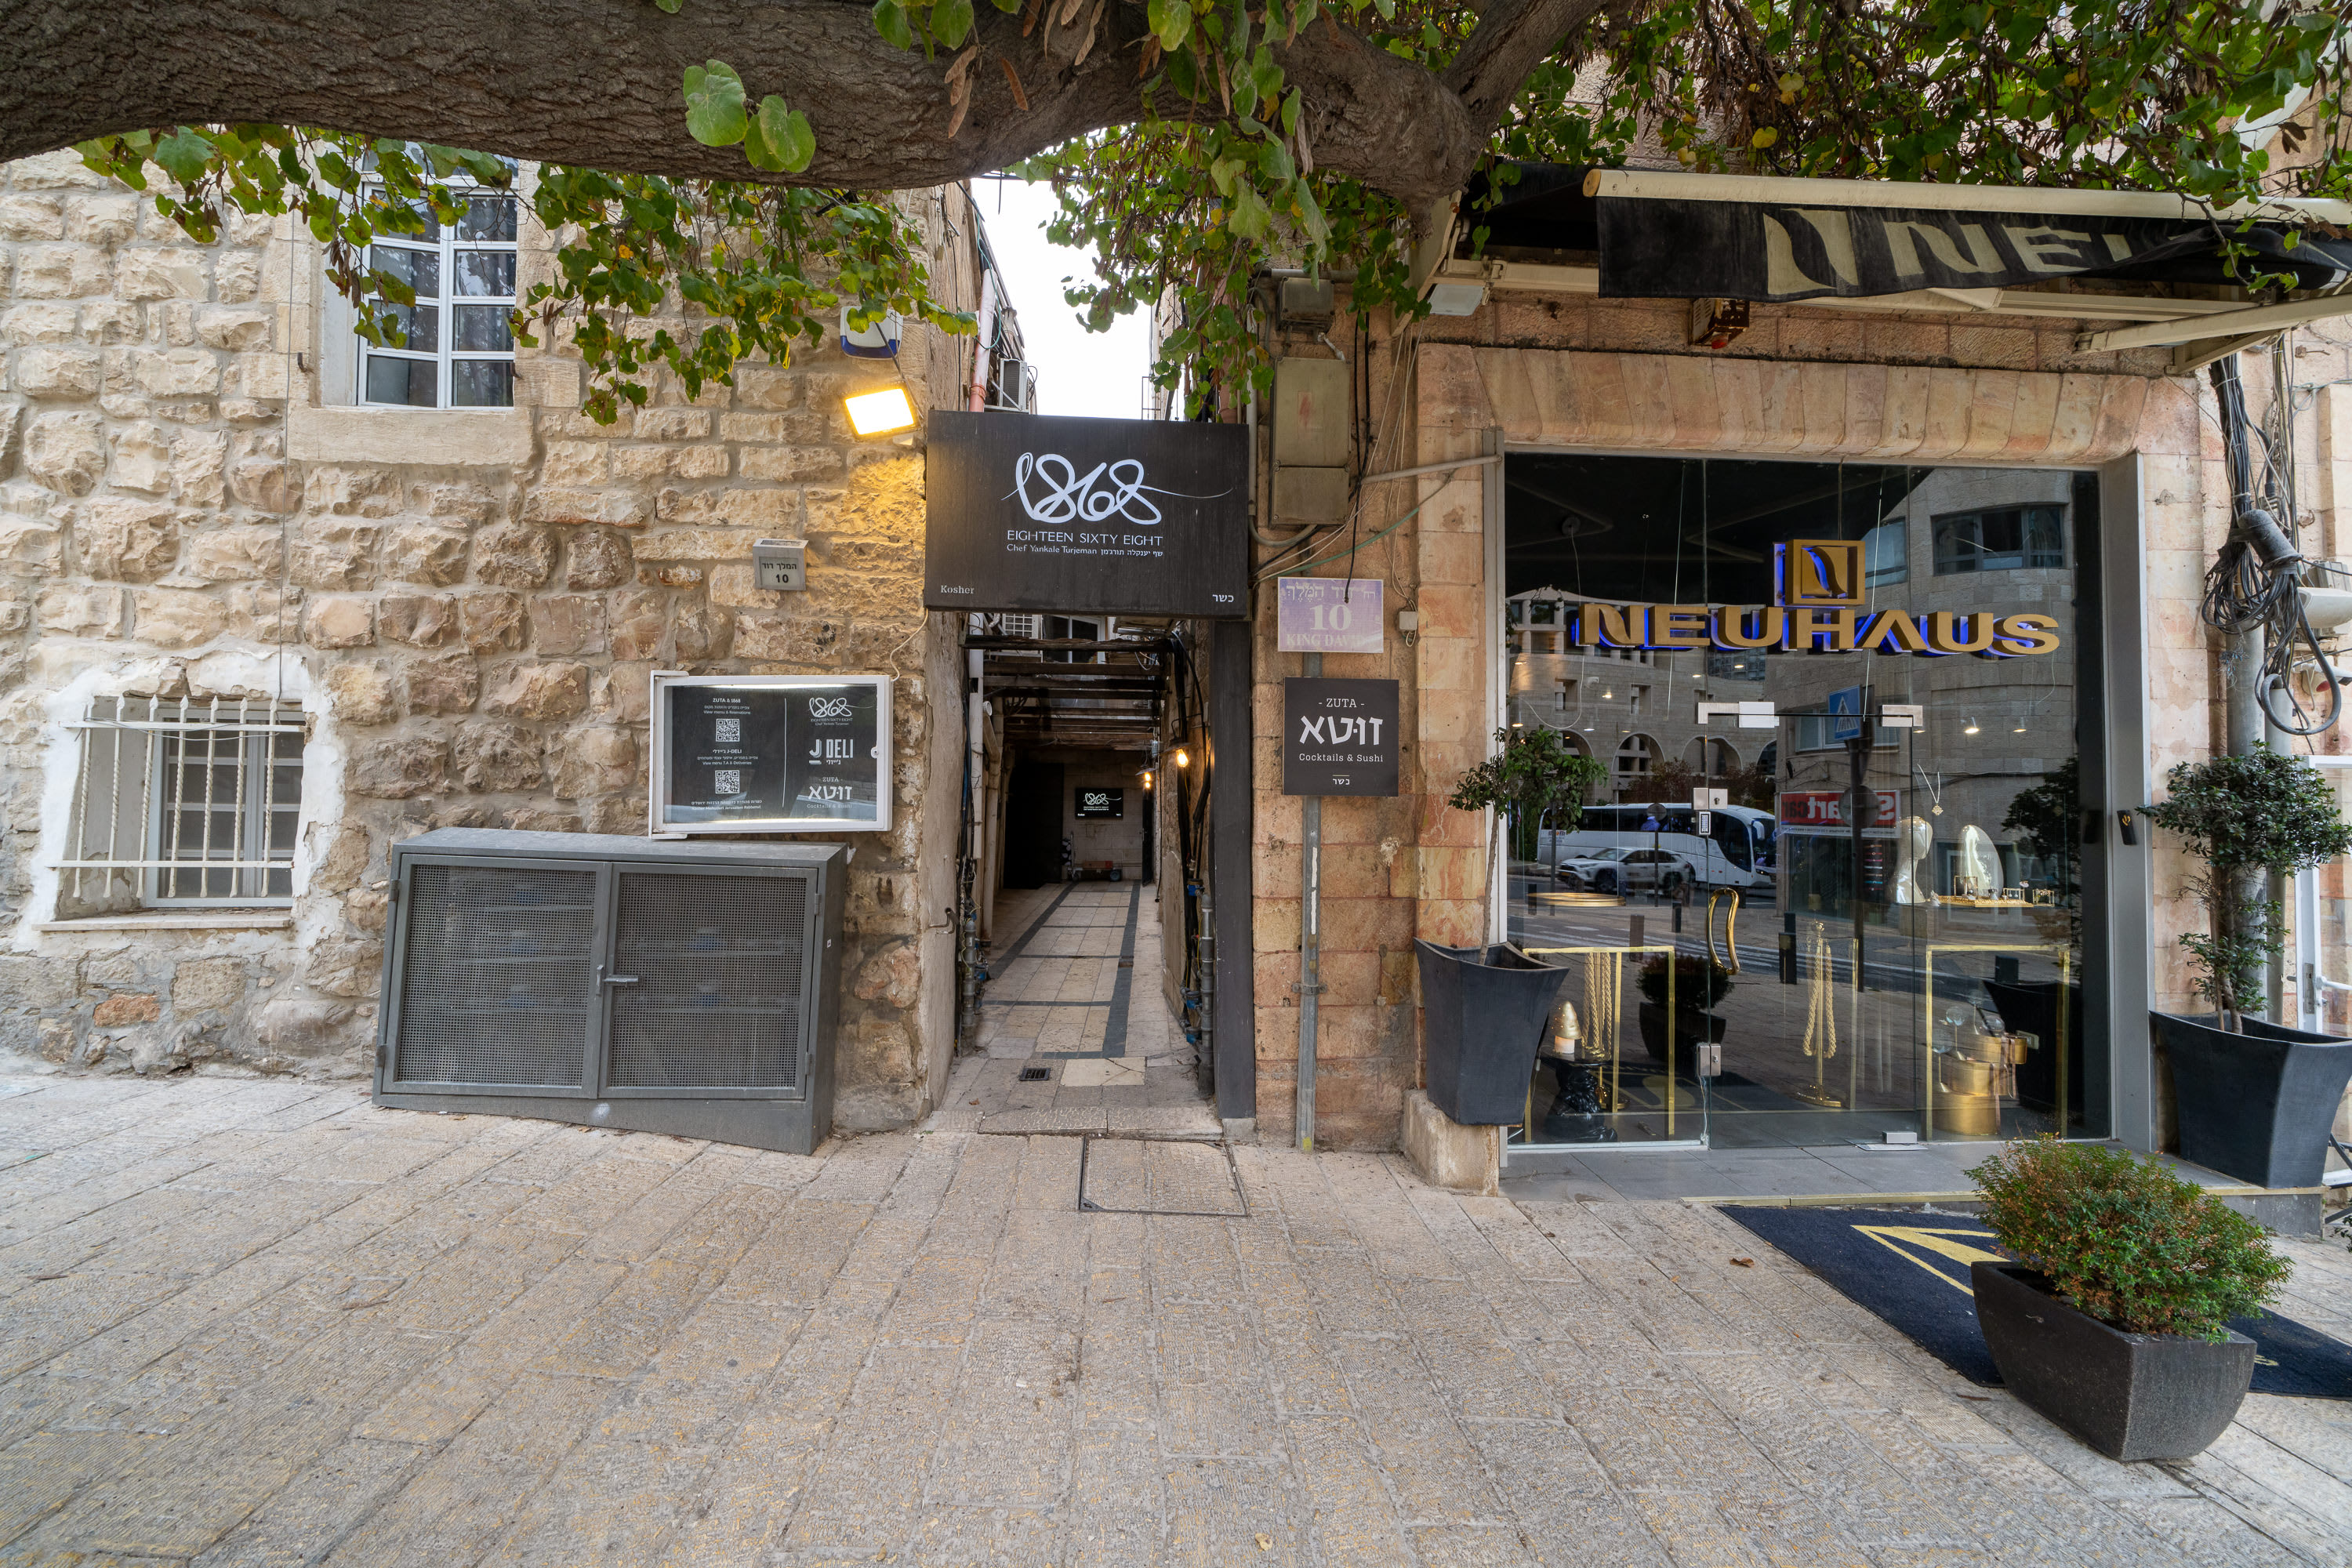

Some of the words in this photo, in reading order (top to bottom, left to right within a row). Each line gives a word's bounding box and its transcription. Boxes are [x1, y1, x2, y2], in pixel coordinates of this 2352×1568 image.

[1001, 452, 1167, 525] 1868
[1007, 530, 1074, 543] EIGHTEEN
[1080, 532, 1119, 545] SIXTY
[1123, 535, 1163, 546] EIGHT
[1007, 543, 1027, 552] Chef
[1062, 546, 1098, 555] Turjeman
[776, 561, 797, 571] המלך
[775, 574, 789, 583] 10
[941, 585, 975, 594] Kosher
[1212, 594, 1234, 603] כשר
[1309, 604, 1352, 631] 10
[1576, 602, 2060, 655] NEUHAUS
[1286, 633, 1320, 647] KING
[1326, 698, 1357, 708] ZUTA
[808, 739, 822, 758] J
[826, 739, 854, 758] DELI
[1299, 753, 1344, 762] Cocktails
[1347, 753, 1354, 762] &
[1356, 754, 1384, 763] Sushi
